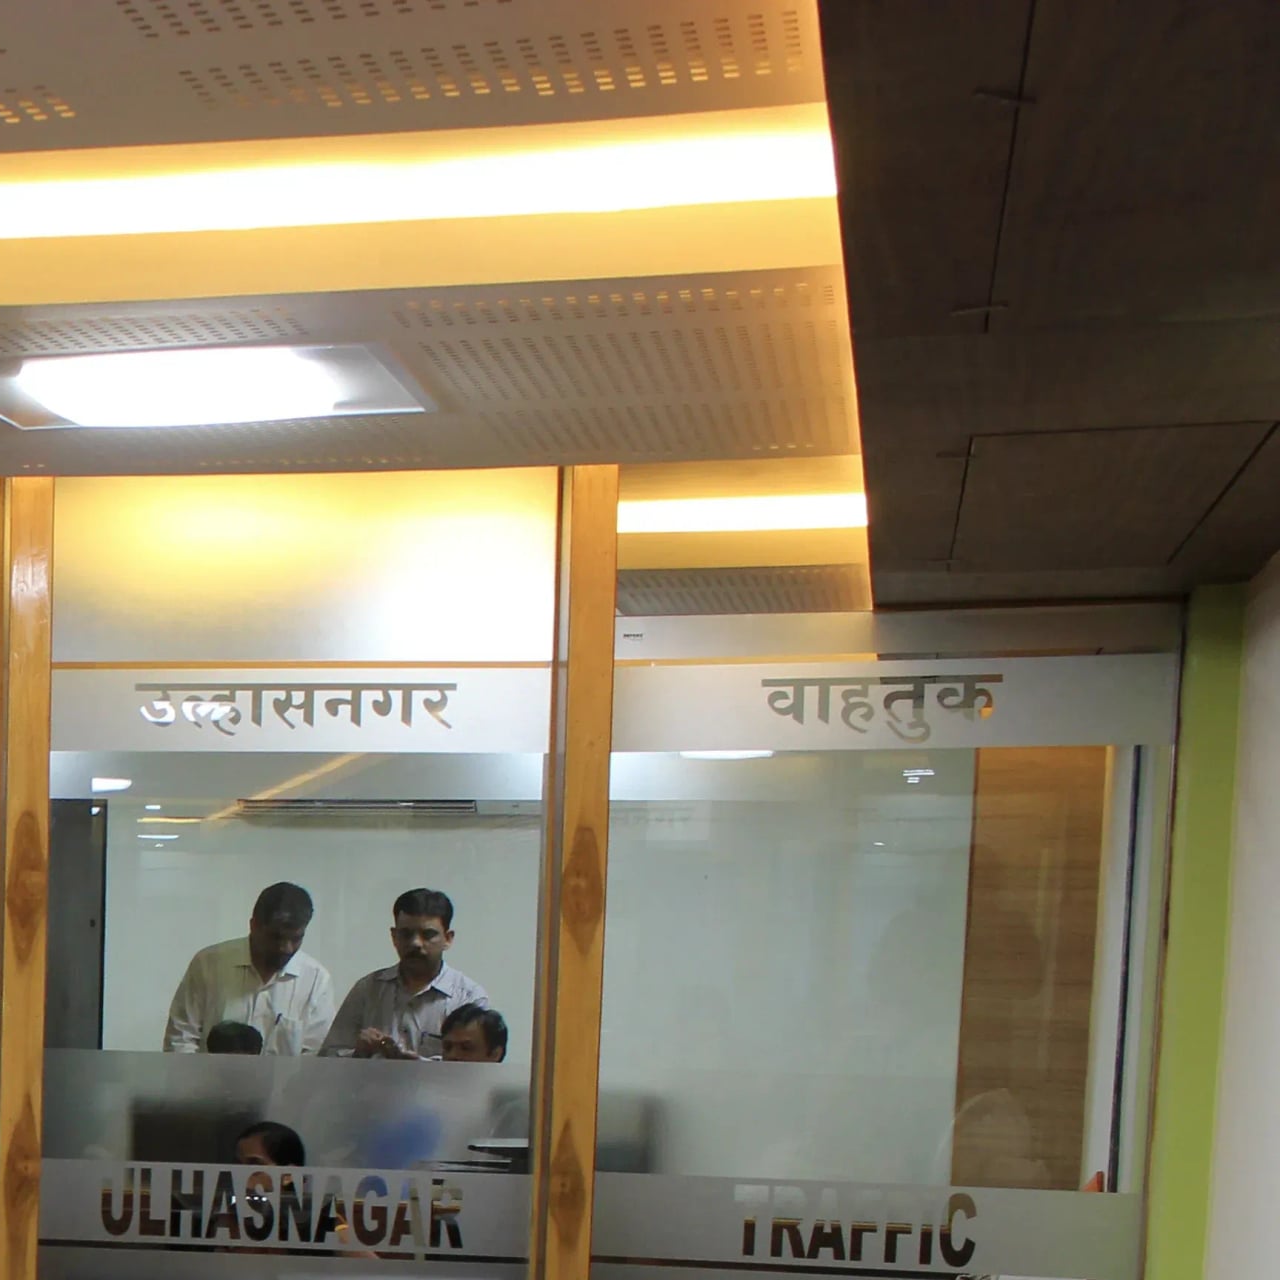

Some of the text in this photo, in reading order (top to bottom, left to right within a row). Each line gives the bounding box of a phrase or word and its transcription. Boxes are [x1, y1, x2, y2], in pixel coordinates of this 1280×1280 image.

[134, 683, 457, 736] उल्हासनगर
[761, 674, 1003, 744] वाहतुक
[100, 1167, 464, 1249] ULHASNAGAR
[733, 1184, 978, 1268] TRAFFIC
